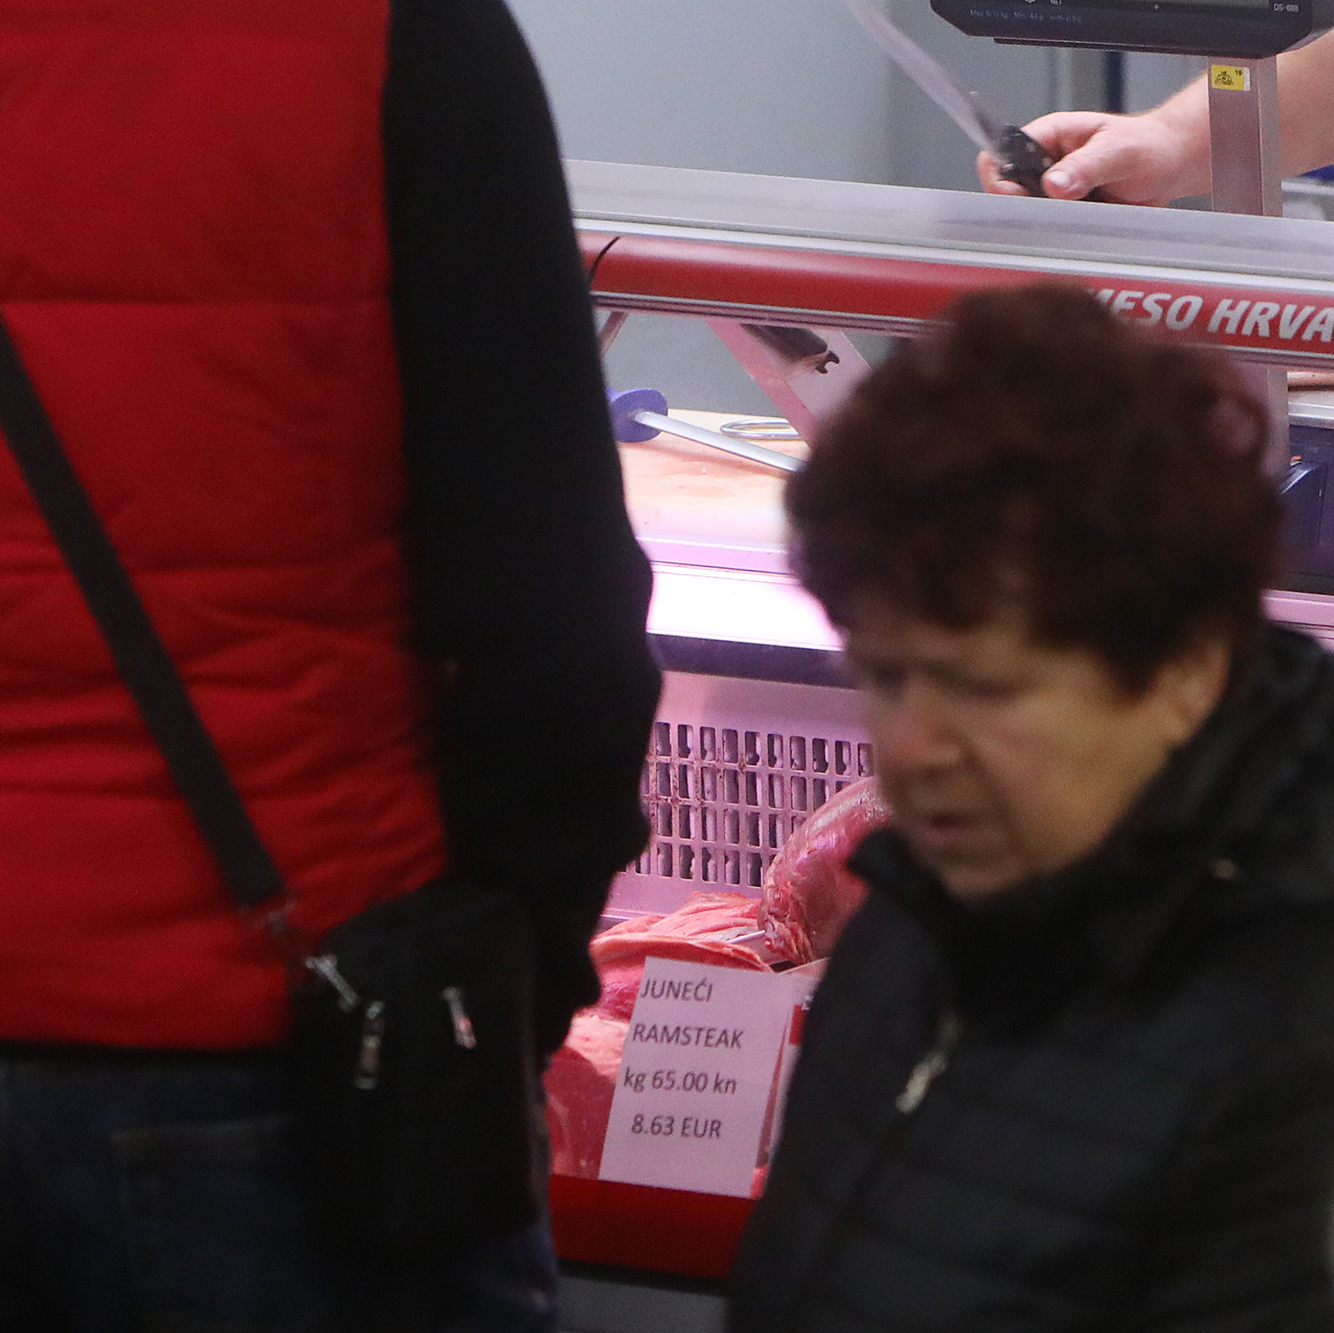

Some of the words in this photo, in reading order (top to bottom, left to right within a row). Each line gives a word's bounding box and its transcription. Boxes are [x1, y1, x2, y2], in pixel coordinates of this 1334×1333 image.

[1087, 288, 1204, 331] ESO
[640, 978, 713, 1003] JUNEĆI
[632, 1023, 745, 1050] RAMSTEAK
[623, 1067, 647, 1093] kg
[652, 1070, 708, 1093] 65.00
[713, 1073, 737, 1095] kn
[631, 1113, 674, 1136] 8.63
[680, 1117, 722, 1140] EUR
